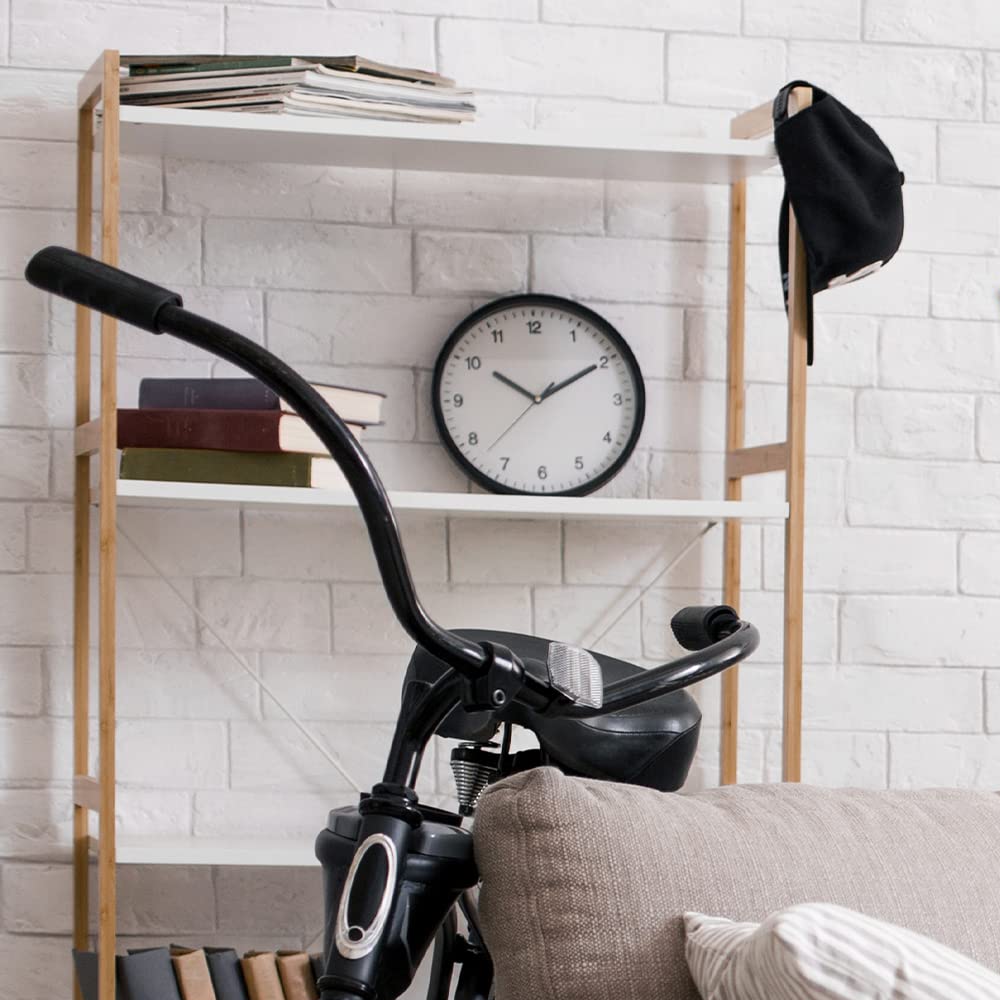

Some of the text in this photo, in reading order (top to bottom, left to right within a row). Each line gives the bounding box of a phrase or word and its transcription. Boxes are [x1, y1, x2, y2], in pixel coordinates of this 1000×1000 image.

[526, 321, 541, 334] 12
[491, 330, 503, 343] 11
[570, 330, 575, 342] 1
[465, 356, 481, 370] 10
[600, 356, 610, 368] 2
[454, 394, 463, 407] 9
[612, 393, 623, 406] 3
[468, 432, 478, 445] 8
[603, 432, 612, 443] 4
[500, 457, 510, 471] 7
[575, 456, 583, 470] 5
[537, 466, 547, 479] 6
